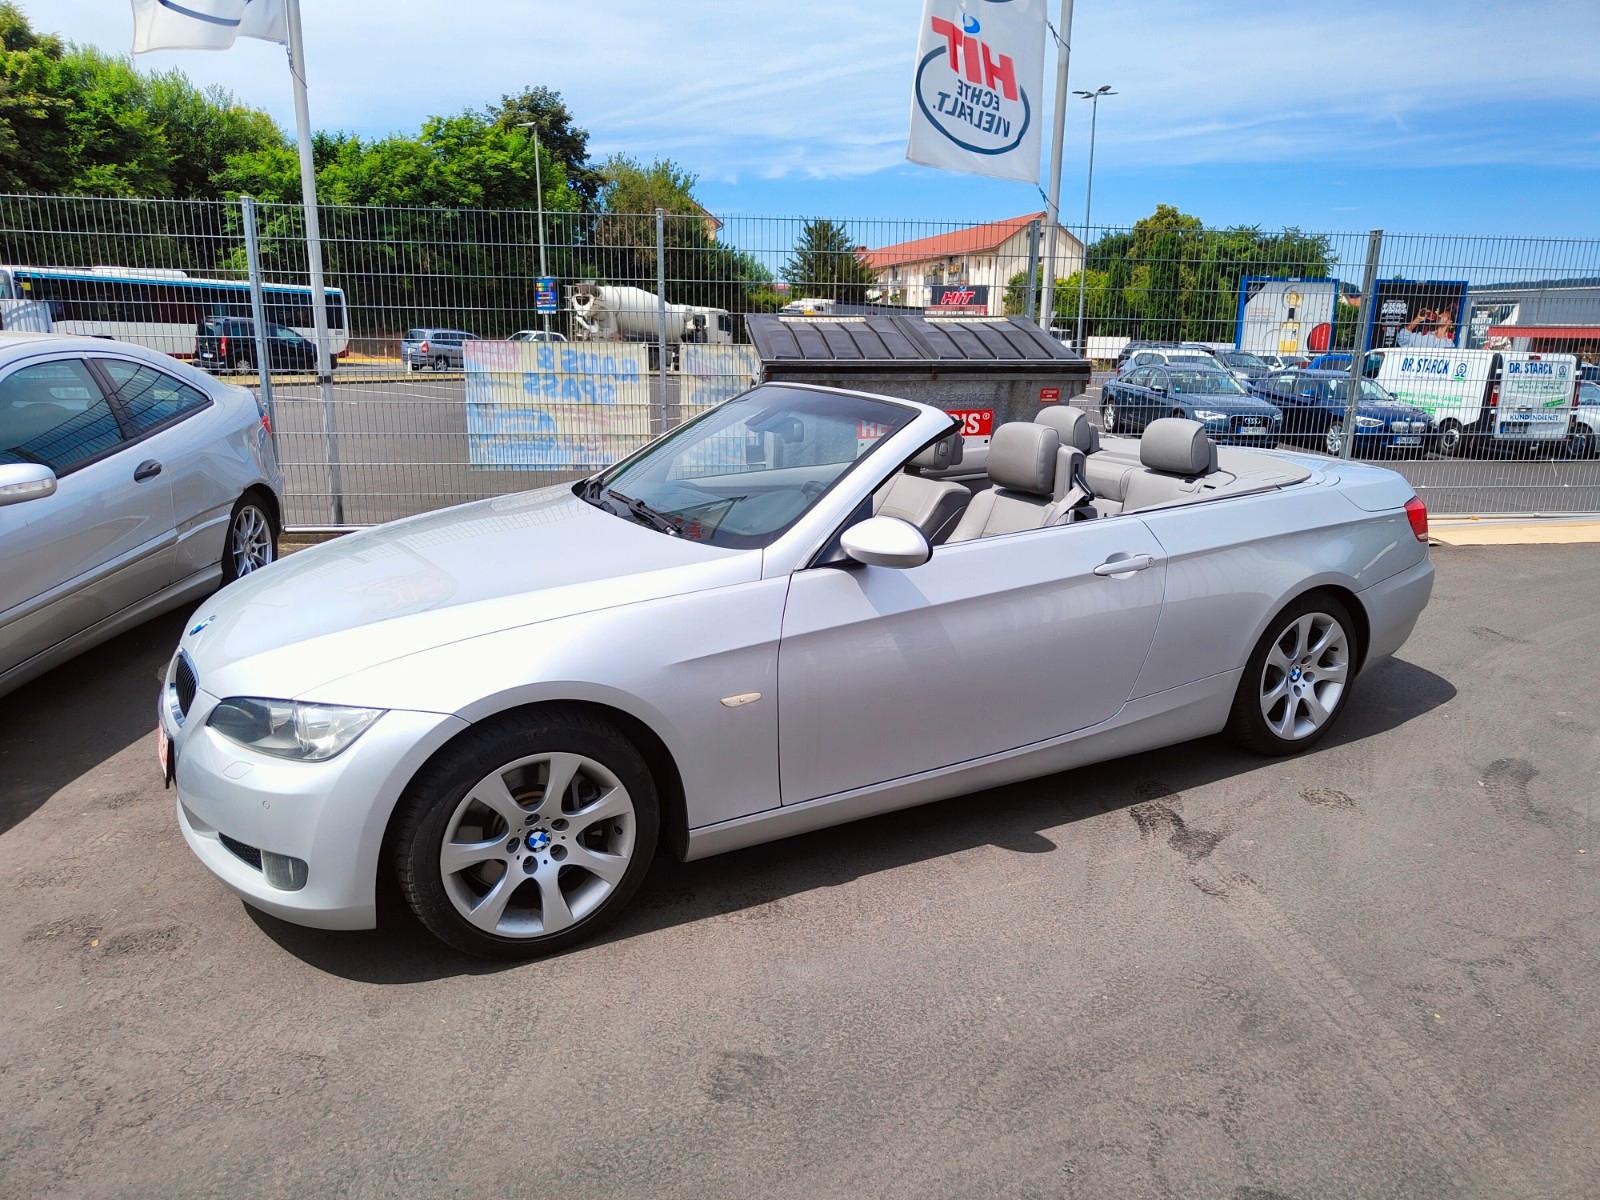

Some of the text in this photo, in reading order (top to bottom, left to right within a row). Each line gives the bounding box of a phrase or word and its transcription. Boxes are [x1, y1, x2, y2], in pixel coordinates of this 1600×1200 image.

[940, 291, 976, 304] HIT
[1417, 358, 1450, 374] STARCK
[1524, 362, 1553, 374] STARCK
